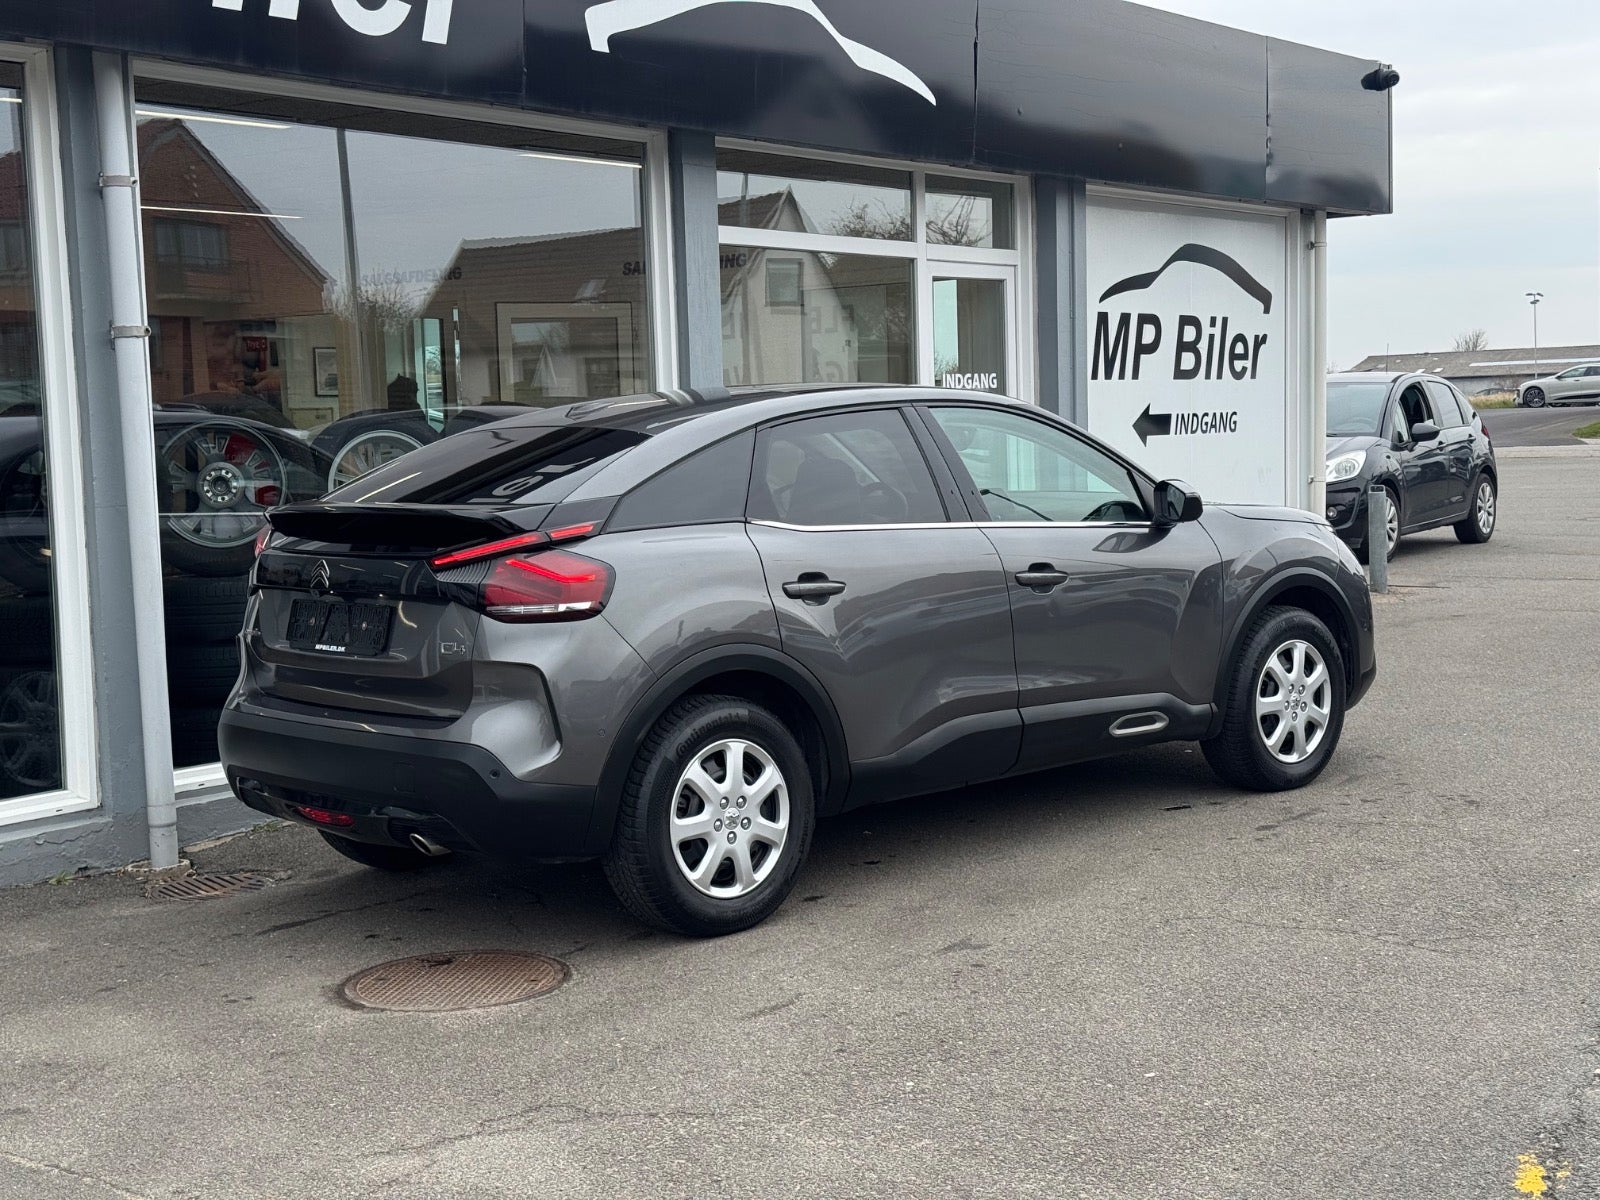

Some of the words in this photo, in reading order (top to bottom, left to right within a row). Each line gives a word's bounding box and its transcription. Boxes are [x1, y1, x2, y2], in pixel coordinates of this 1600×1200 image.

[1091, 311, 1162, 381] MP
[1172, 314, 1268, 381] Biler
[942, 372, 998, 389] INDGANG
[1174, 411, 1238, 436] INDGANG
